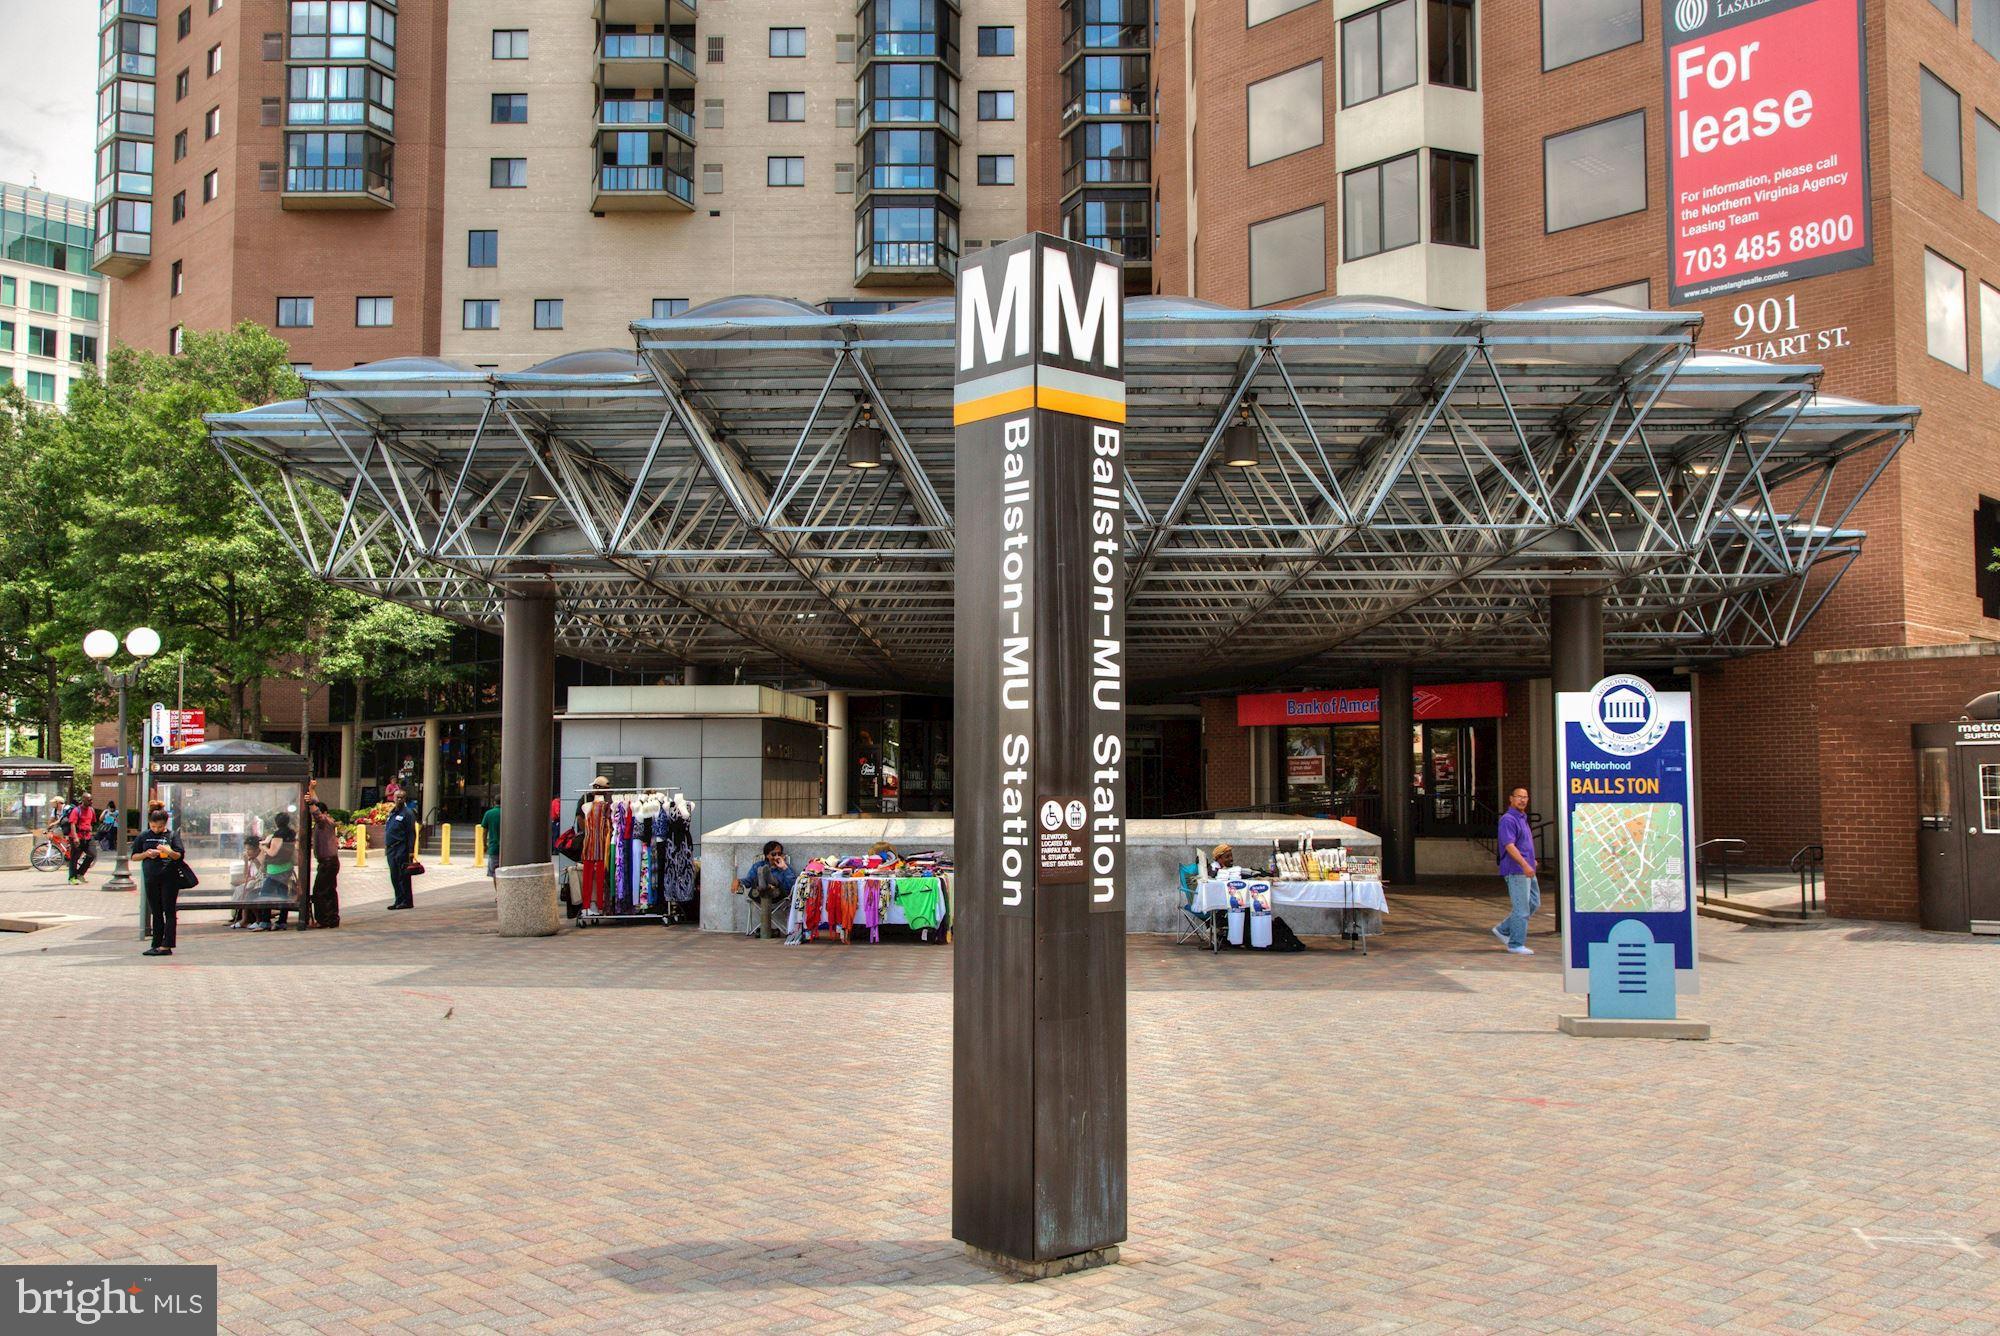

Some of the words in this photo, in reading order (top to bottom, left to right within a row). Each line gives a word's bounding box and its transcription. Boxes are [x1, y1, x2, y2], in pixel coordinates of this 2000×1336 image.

[1678, 41, 1760, 100] For
[1679, 89, 1813, 158] lease
[1681, 191, 1700, 204] For
[1703, 174, 1771, 199] information,
[1774, 163, 1813, 184] please
[1816, 154, 1838, 171] call
[1681, 208, 1698, 220] the
[1702, 194, 1751, 215] Northern
[1754, 183, 1799, 203] Virginia
[1802, 172, 1848, 193] Agency
[1682, 219, 1726, 237] Leasing
[1729, 211, 1759, 226] Team
[1683, 243, 1727, 275] 703
[1734, 231, 1781, 263] 485
[1789, 214, 1853, 252] 8800
[960, 249, 1031, 371] M
[1043, 246, 1119, 369] M
[1733, 293, 1800, 340] 901
[1720, 333, 1811, 361] TUART
[1818, 327, 1850, 350] ST.
[1287, 698, 1322, 716] Bank
[1323, 697, 1337, 714] of
[1631, 680, 1653, 700] COUNTY
[161, 764, 180, 773] 10B
[183, 764, 202, 773] 23A
[205, 764, 225, 773] 23B
[228, 764, 247, 773] 23T
[1570, 761, 1631, 772] Neighborhood
[1571, 778, 1660, 795] BALLSTON
[1002, 733, 1029, 906] Station
[1093, 734, 1121, 903] Station
[1048, 853, 1067, 861] STUART
